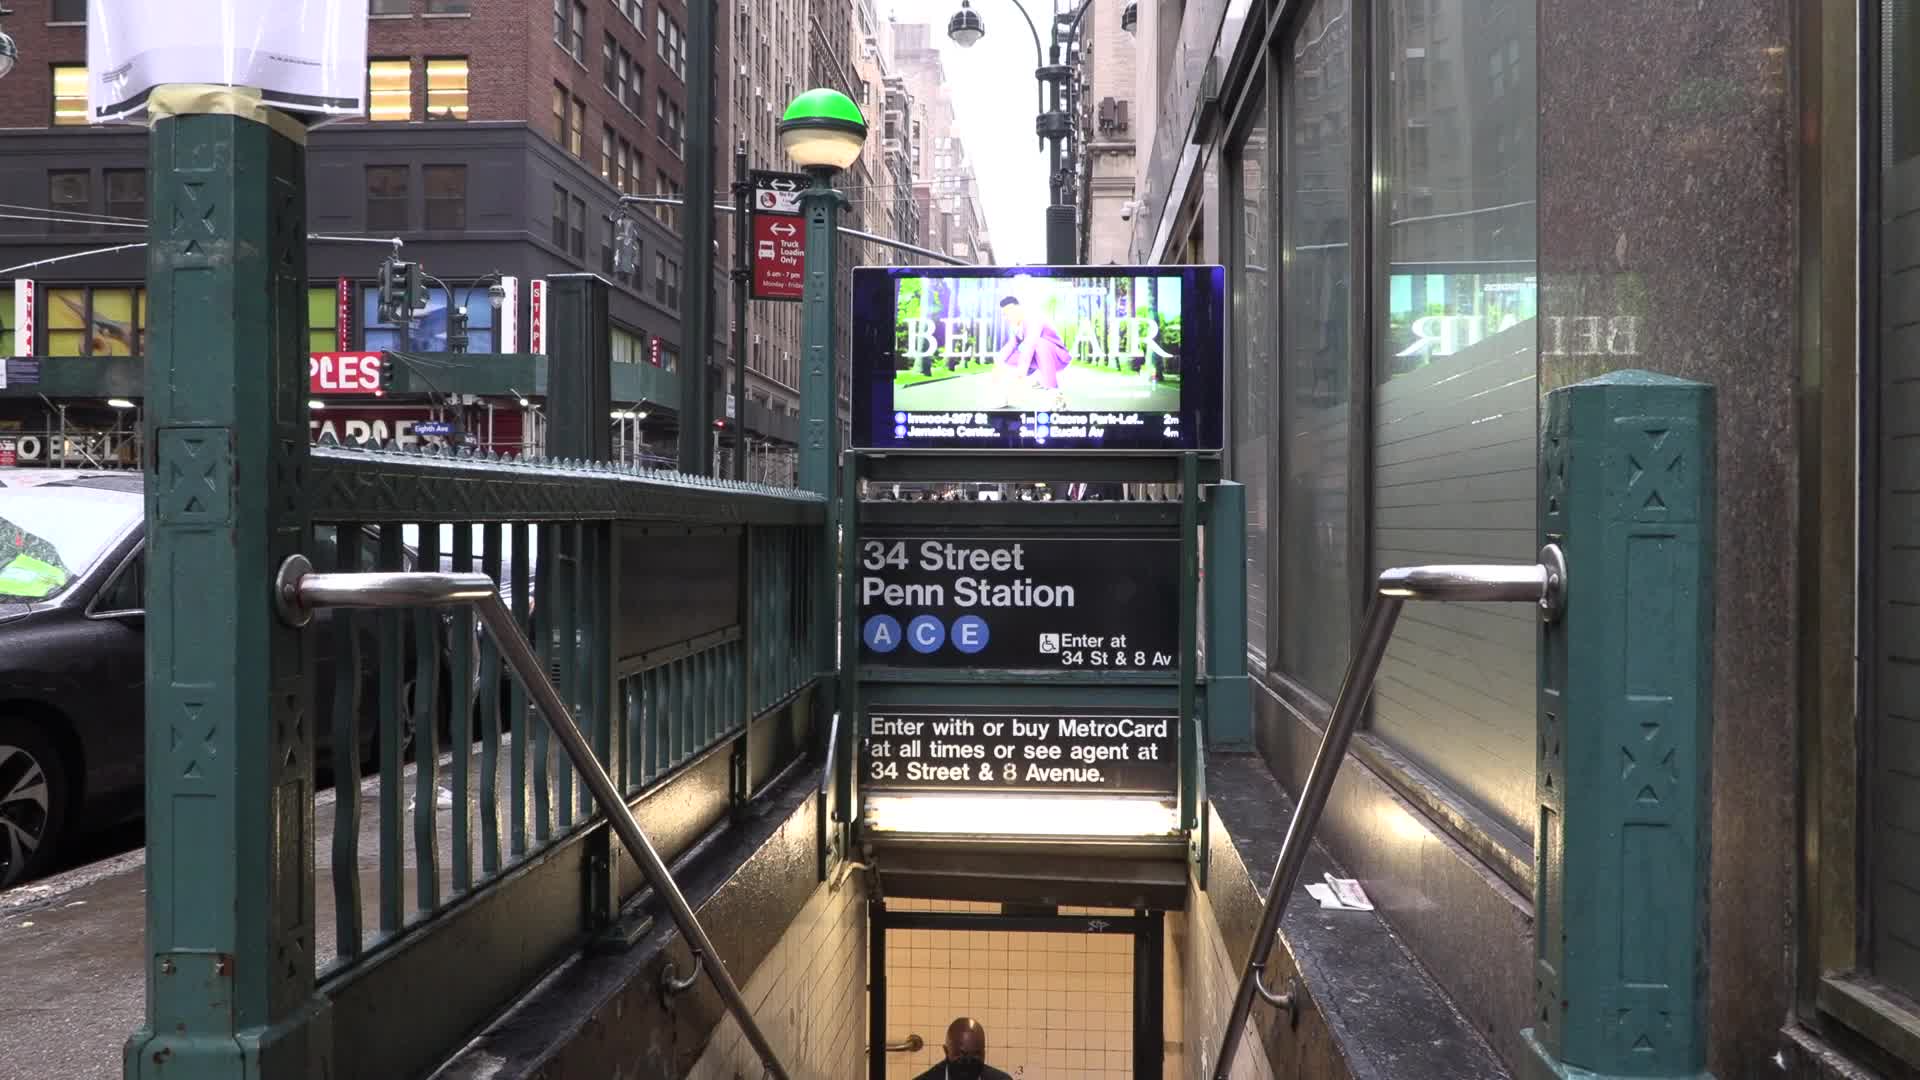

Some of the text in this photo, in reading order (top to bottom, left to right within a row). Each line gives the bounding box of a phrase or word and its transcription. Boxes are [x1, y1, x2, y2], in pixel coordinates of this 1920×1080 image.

[781, 240, 799, 248] Truck
[780, 248, 804, 256] Loadin
[780, 257, 797, 266] Only
[763, 280, 784, 289] Monday
[1070, 317, 1174, 358] AIR
[1163, 414, 1180, 425] 2m
[415, 425, 435, 434] Eighth
[1088, 426, 1105, 437] Av
[1163, 427, 1180, 437] 4m
[863, 541, 1025, 571] 34 Street
[863, 577, 1075, 607] Penn Station
[873, 623, 979, 646] A C E
[1061, 633, 1127, 648] Enter at
[1061, 651, 1172, 666] 34 St & 8 Av
[870, 717, 1168, 741] Enter with or buy MetroCard
[871, 741, 1159, 764] at all times or see agent at
[871, 762, 1106, 783] 34 Street & 8 Avenue.
